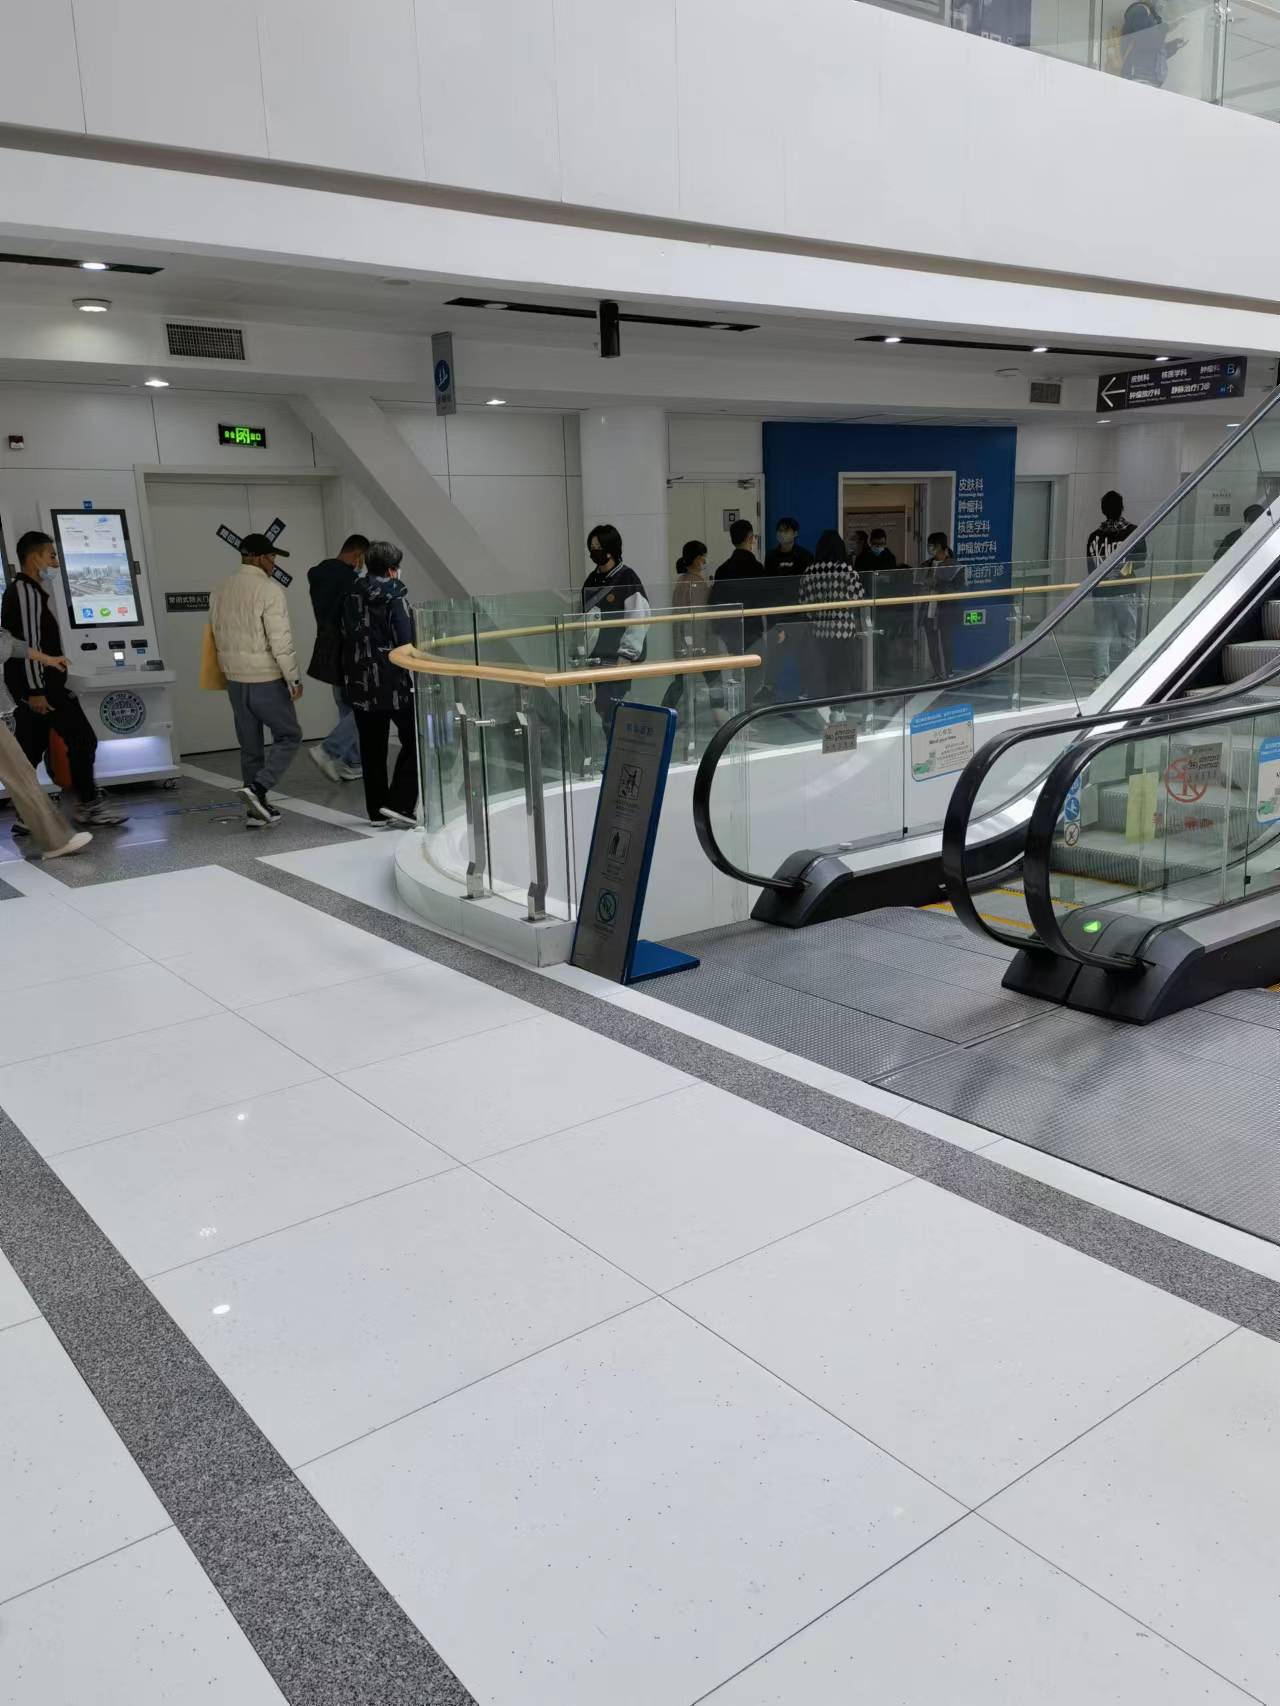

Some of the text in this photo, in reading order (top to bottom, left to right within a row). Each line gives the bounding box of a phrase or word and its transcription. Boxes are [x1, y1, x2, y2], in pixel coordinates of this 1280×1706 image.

[959, 478, 984, 491] 皮肤科
[958, 500, 983, 513] 肿瘤科
[957, 520, 990, 533] 核医学科
[957, 540, 997, 555] 肿瘤放疗科
[965, 563, 1005, 579] 脉治疗门诊
